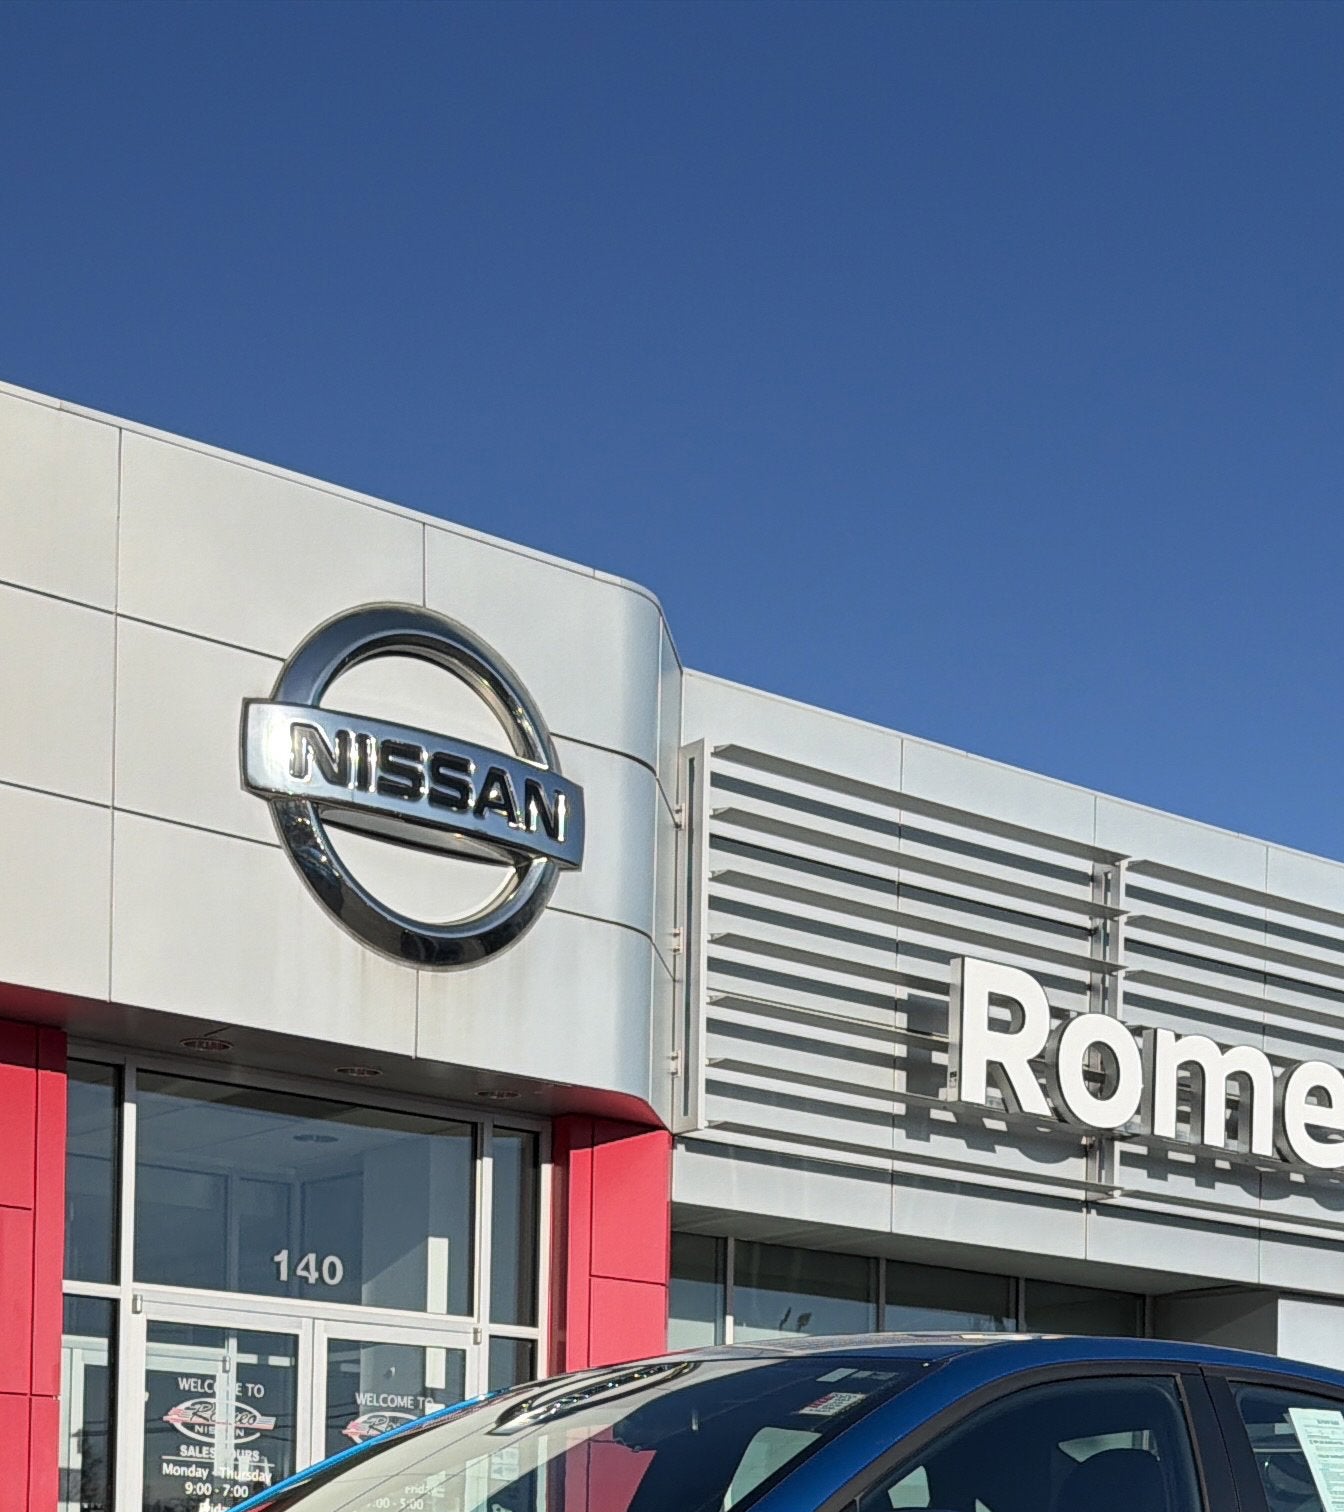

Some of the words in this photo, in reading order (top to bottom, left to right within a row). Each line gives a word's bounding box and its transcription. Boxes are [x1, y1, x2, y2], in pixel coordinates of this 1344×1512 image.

[288, 722, 569, 843] NISSAN
[273, 1249, 344, 1286] 140
[178, 1377, 243, 1396] WELCE
[245, 1383, 265, 1398] TO
[355, 1392, 415, 1409] WELCOME
[179, 1444, 216, 1459] SALES
[162, 1462, 210, 1481] Monday
[219, 1466, 273, 1487] Thursday
[184, 1483, 212, 1496] 9:00
[223, 1484, 249, 1498] 7:00
[399, 1498, 424, 1510] 5:00
